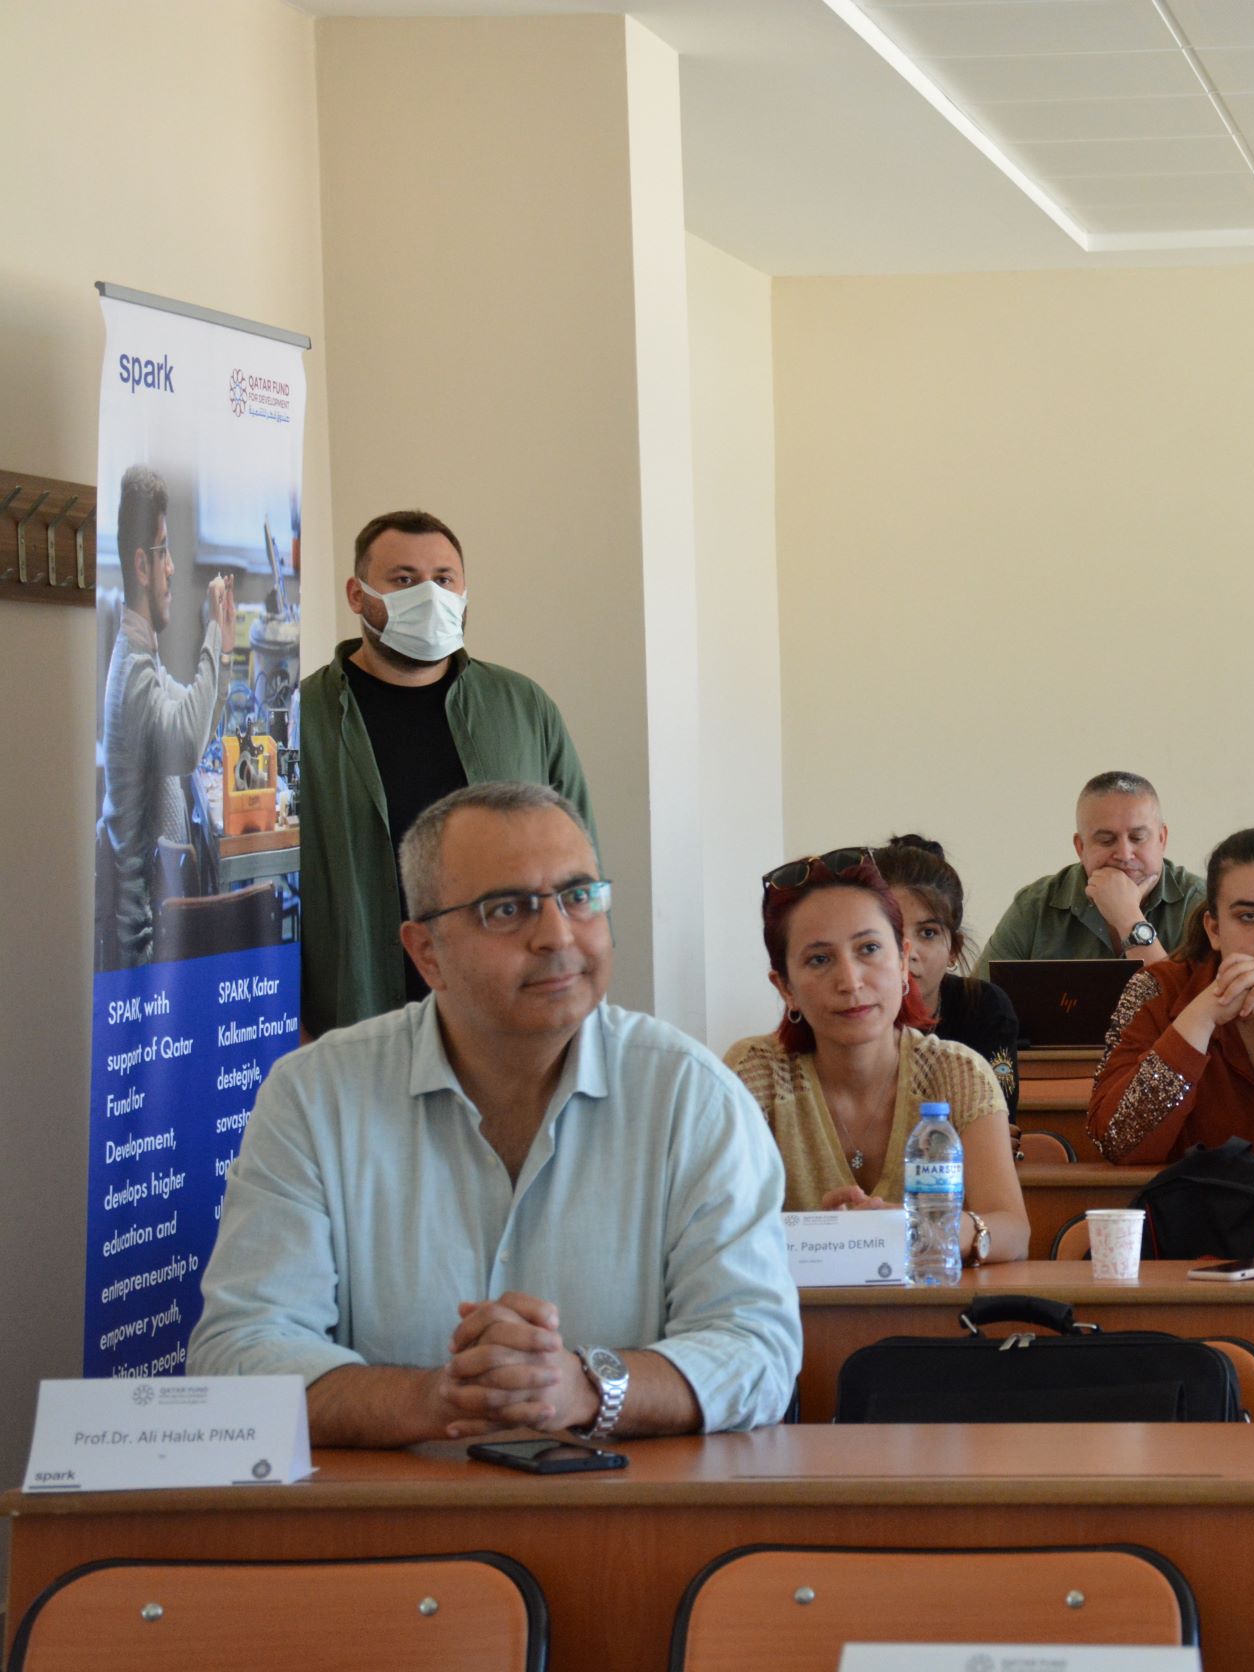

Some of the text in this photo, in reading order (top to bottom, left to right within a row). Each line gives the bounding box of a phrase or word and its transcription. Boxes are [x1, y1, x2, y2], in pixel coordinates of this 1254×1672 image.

[119, 353, 175, 394] spark
[248, 375, 290, 397] QATAR FUND
[218, 976, 279, 1004] SPARK, Katar
[108, 991, 170, 1025] SPARK, with
[218, 1022, 258, 1048] Kalkınma
[107, 1036, 194, 1076] support of Qatar
[107, 1089, 131, 1118] Fund
[105, 1127, 177, 1165] Development,
[104, 1167, 186, 1212] develops higher
[103, 1210, 177, 1257] education and
[801, 1241, 845, 1253] Papatya
[101, 1254, 199, 1304] entrepreneurship to
[100, 1298, 182, 1350] empower youth,
[74, 1428, 256, 1446] Prof.Dr. Ali Haluk PINAR
[34, 1469, 76, 1482] spark
